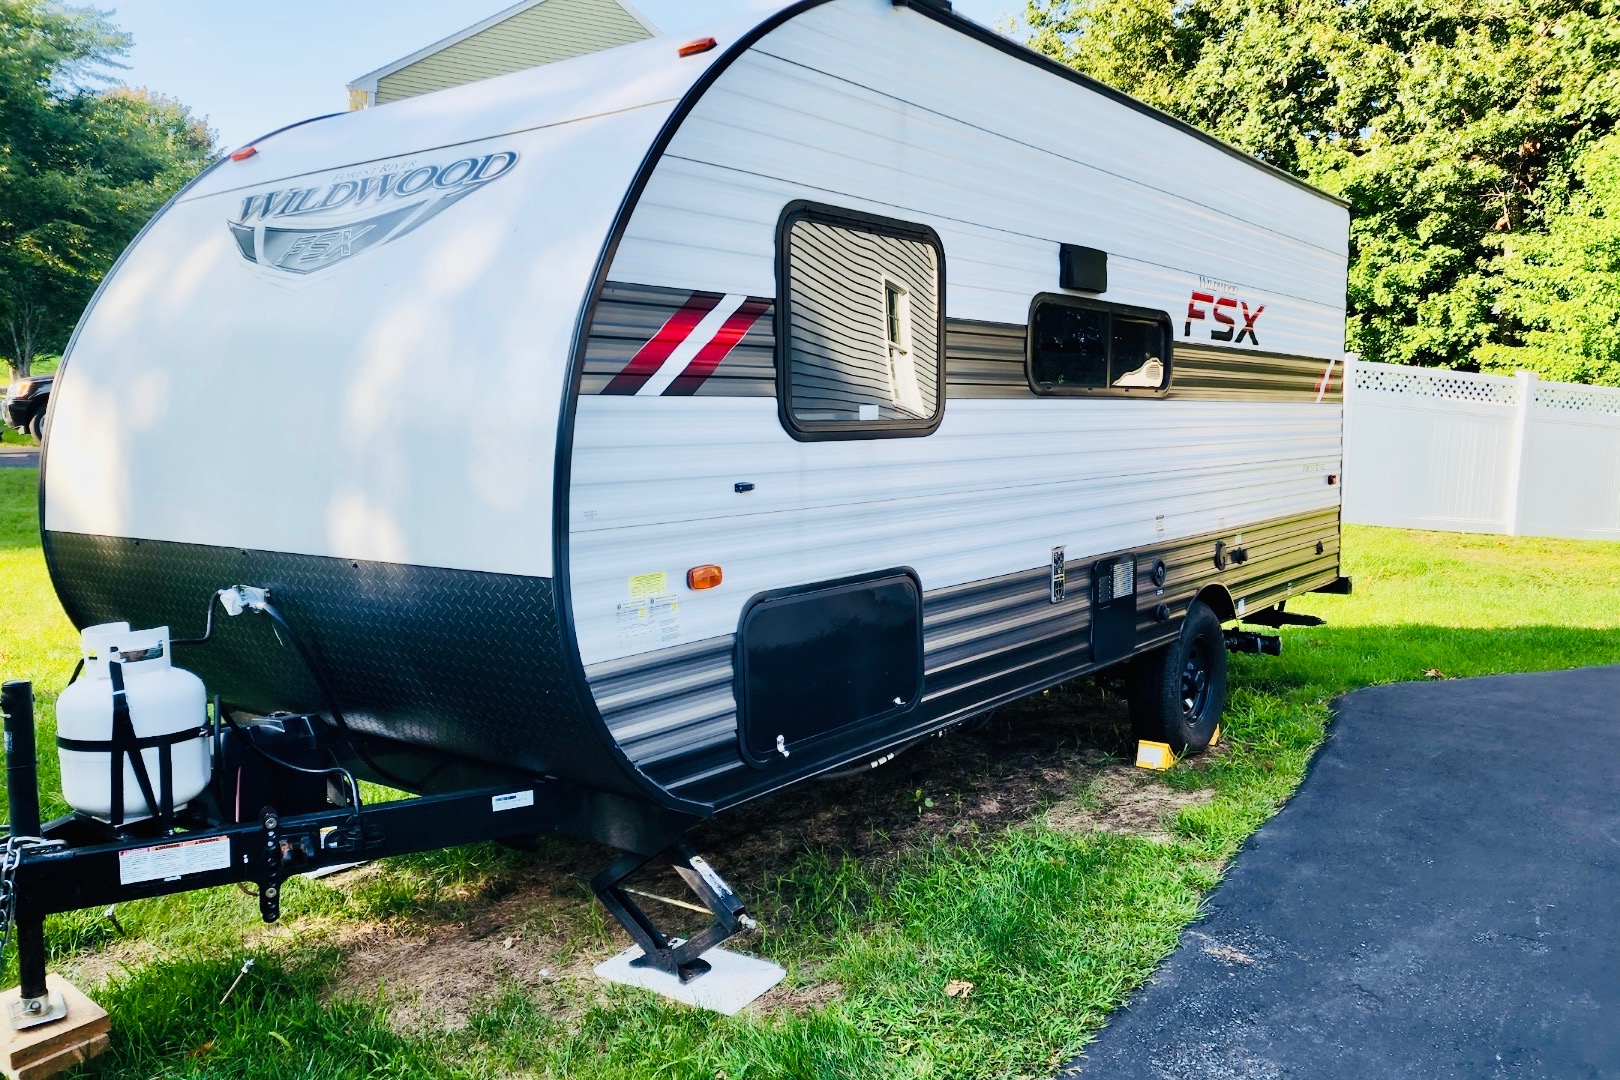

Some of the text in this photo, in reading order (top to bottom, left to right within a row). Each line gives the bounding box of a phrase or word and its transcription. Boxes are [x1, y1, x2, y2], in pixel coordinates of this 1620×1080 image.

[239, 150, 520, 223] WILDWOOD
[333, 159, 417, 182] FOREST RIVER
[275, 225, 377, 266] FSX
[1184, 291, 1267, 346] FSX
